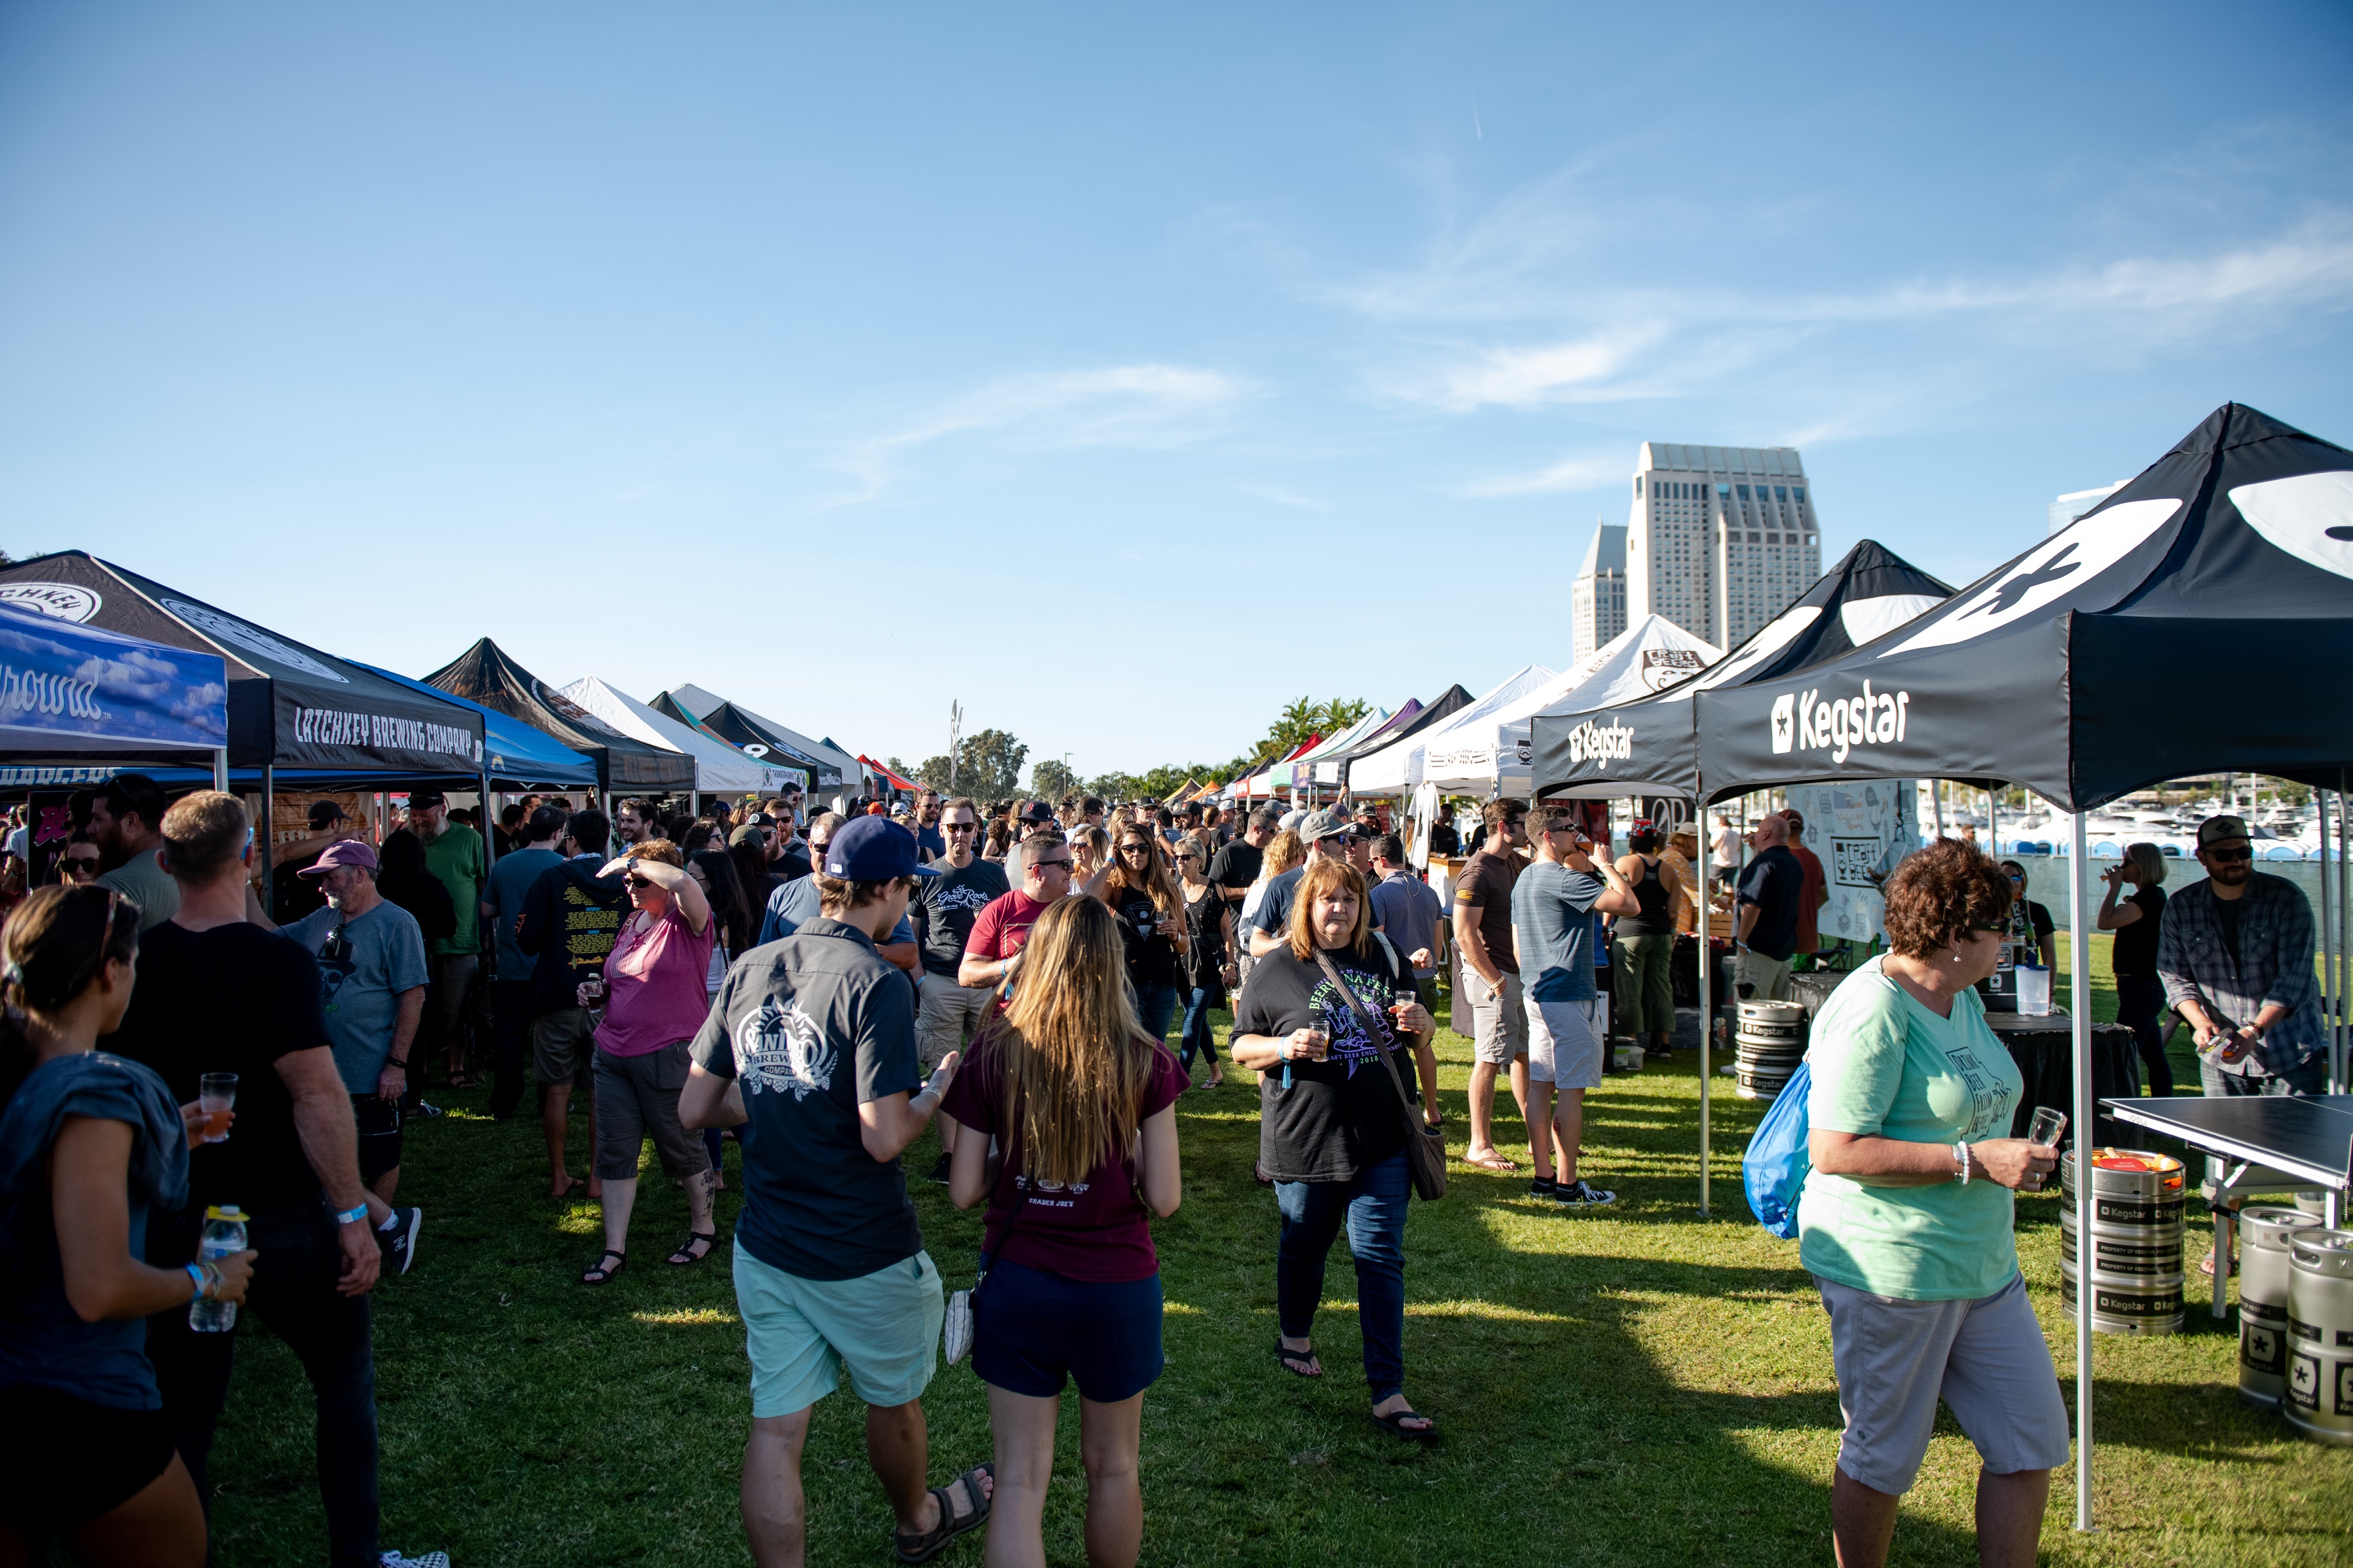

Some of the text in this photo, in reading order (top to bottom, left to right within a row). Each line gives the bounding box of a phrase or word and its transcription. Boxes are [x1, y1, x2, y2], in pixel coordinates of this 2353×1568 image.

[0, 655, 102, 720] round
[1799, 679, 1909, 763] Kegstar
[295, 706, 472, 756] LATCHKEY BREWING COMPANY
[1583, 717, 1634, 770] Kegstar
[938, 889, 990, 905] Grove Roots
[1314, 975, 1330, 989] CHEE
[1356, 970, 1374, 979] YEARS
[1309, 974, 1363, 1010] BEERVNA
[1753, 1025, 1784, 1036] Kegstar
[764, 1065, 794, 1076] COMPAN
[1951, 1054, 1980, 1072] DRINK
[1751, 1079, 1782, 1089] Kegstar
[1964, 1073, 1986, 1091] BEER
[1976, 1093, 1992, 1113] FROM
[1971, 1115, 1989, 1133] HERE
[2129, 1114, 2147, 1126] JOOLA
[1028, 1198, 1054, 1207] TRADER
[2065, 1196, 2076, 1208] Kegs
[2111, 1207, 2146, 1219] Kegstar
[394, 1234, 406, 1251] N
[2101, 1245, 2126, 1253] PROPERTY
[2101, 1262, 2126, 1270] PROPERTY
[2110, 1299, 2145, 1311] Kegstar
[2290, 1388, 2315, 1404] Kegstar
